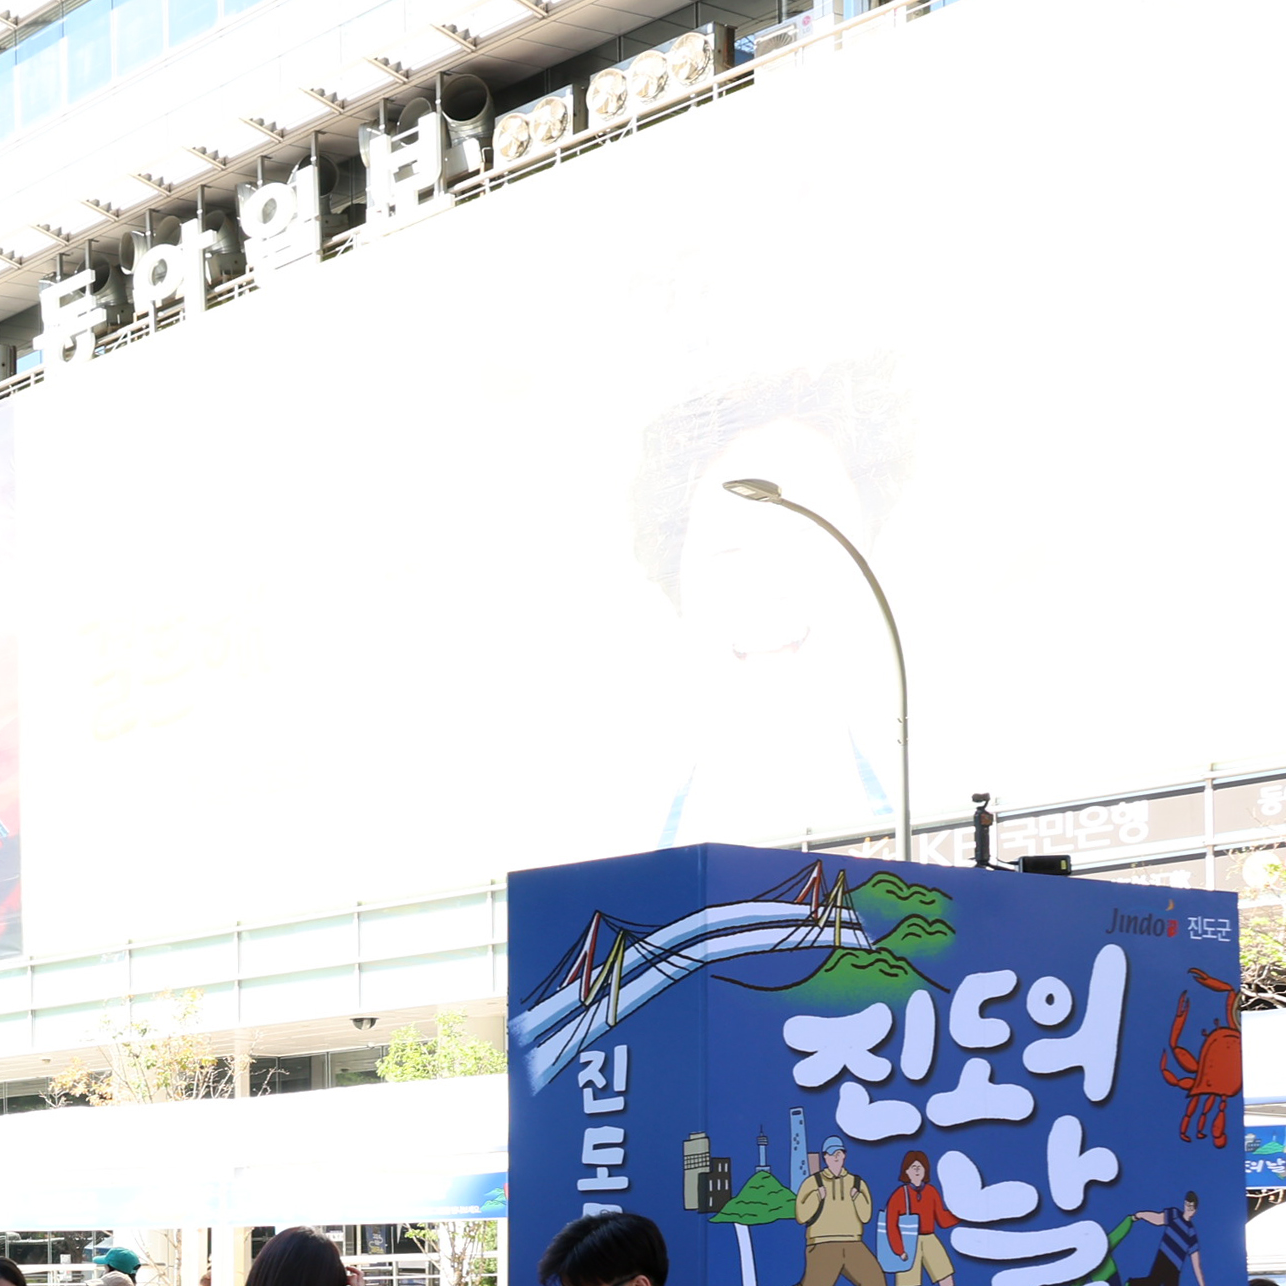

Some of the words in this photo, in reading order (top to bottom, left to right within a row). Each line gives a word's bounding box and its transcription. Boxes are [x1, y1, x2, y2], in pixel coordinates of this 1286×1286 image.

[34, 110, 456, 366] 동아일보
[1256, 783, 1286, 816] 동
[1000, 800, 1150, 856] 국민은행
[1106, 907, 1166, 938] Jindo
[1187, 915, 1232, 943] 진도군
[781, 941, 1128, 1142] 진도의
